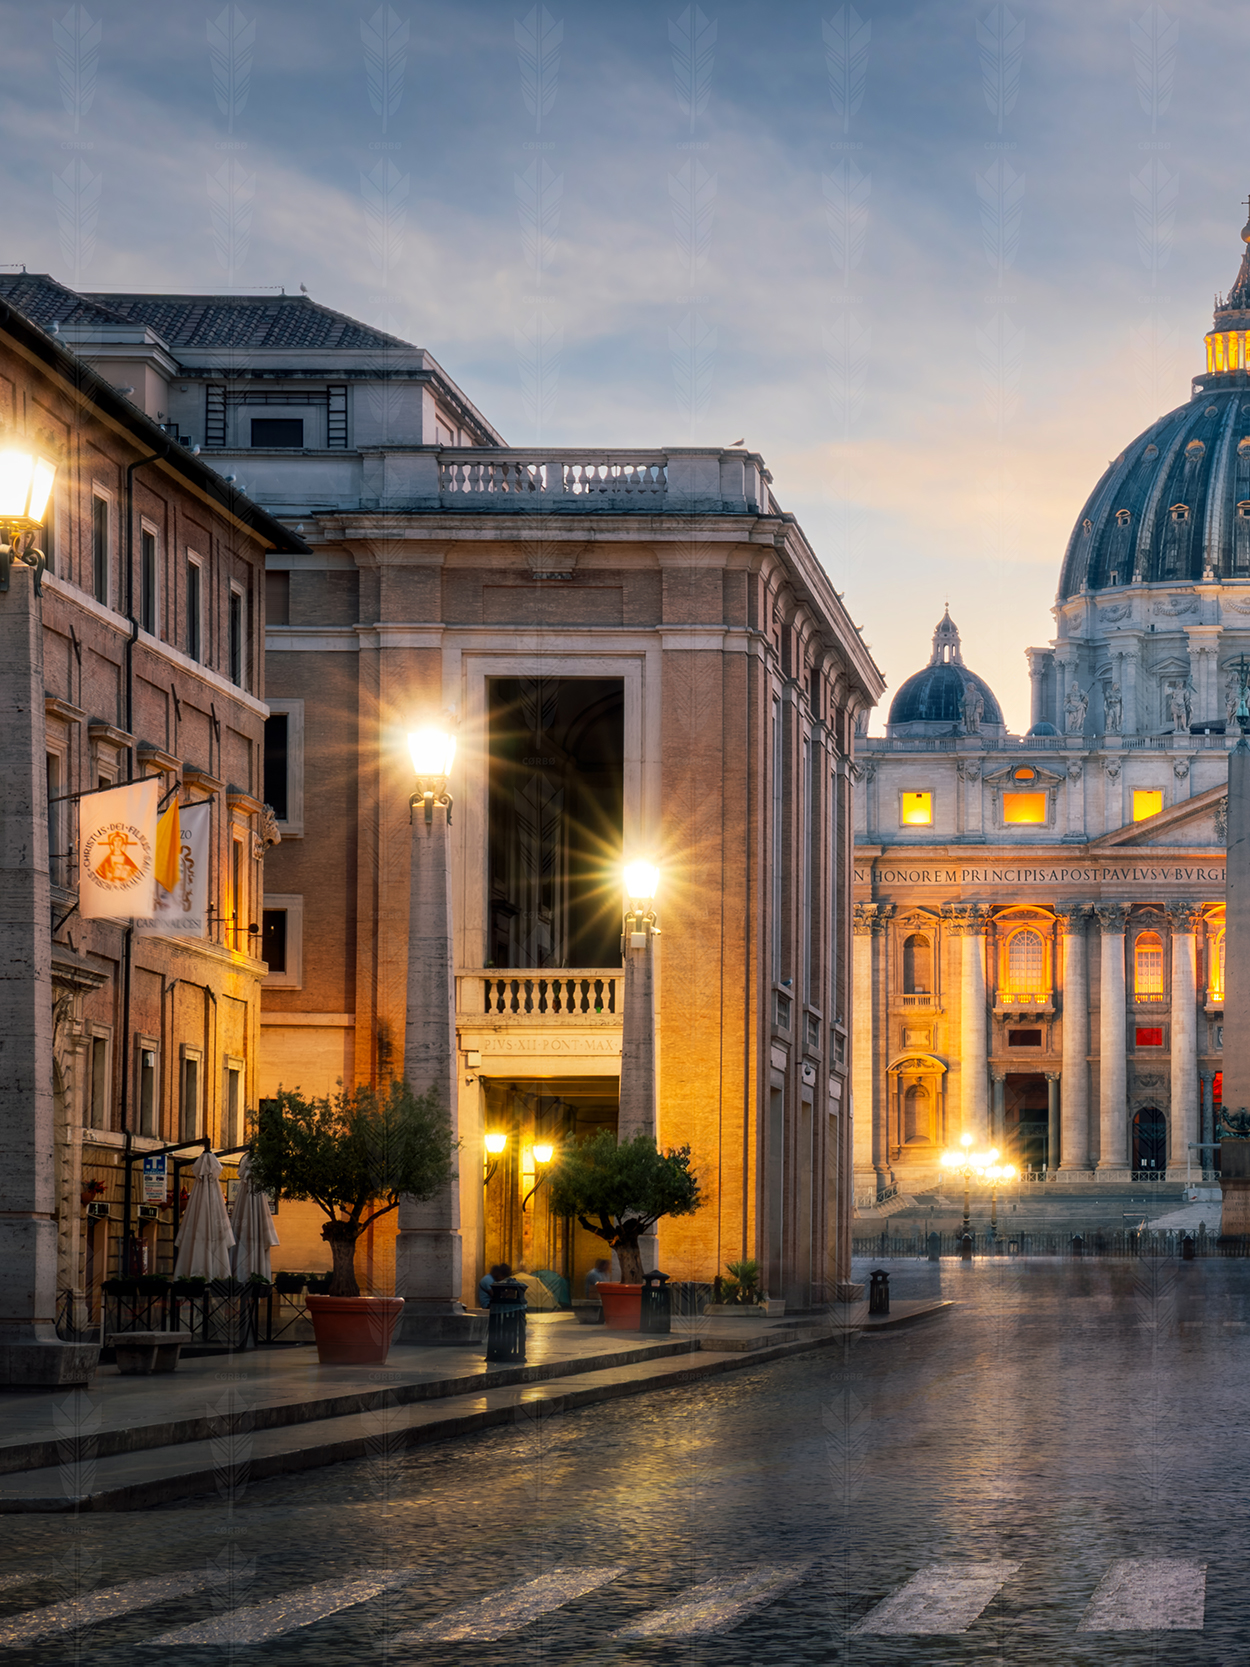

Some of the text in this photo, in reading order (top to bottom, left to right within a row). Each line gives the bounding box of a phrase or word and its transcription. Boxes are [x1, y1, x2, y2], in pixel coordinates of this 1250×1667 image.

[109, 822, 125, 831] DEI
[872, 869, 958, 883] HONOREM
[961, 869, 1046, 883] PRINCIPIS
[1049, 869, 1100, 883] APOST
[1101, 869, 1158, 883] PAVLVS
[484, 1039, 615, 1051] PIVS XII PONT MAX
